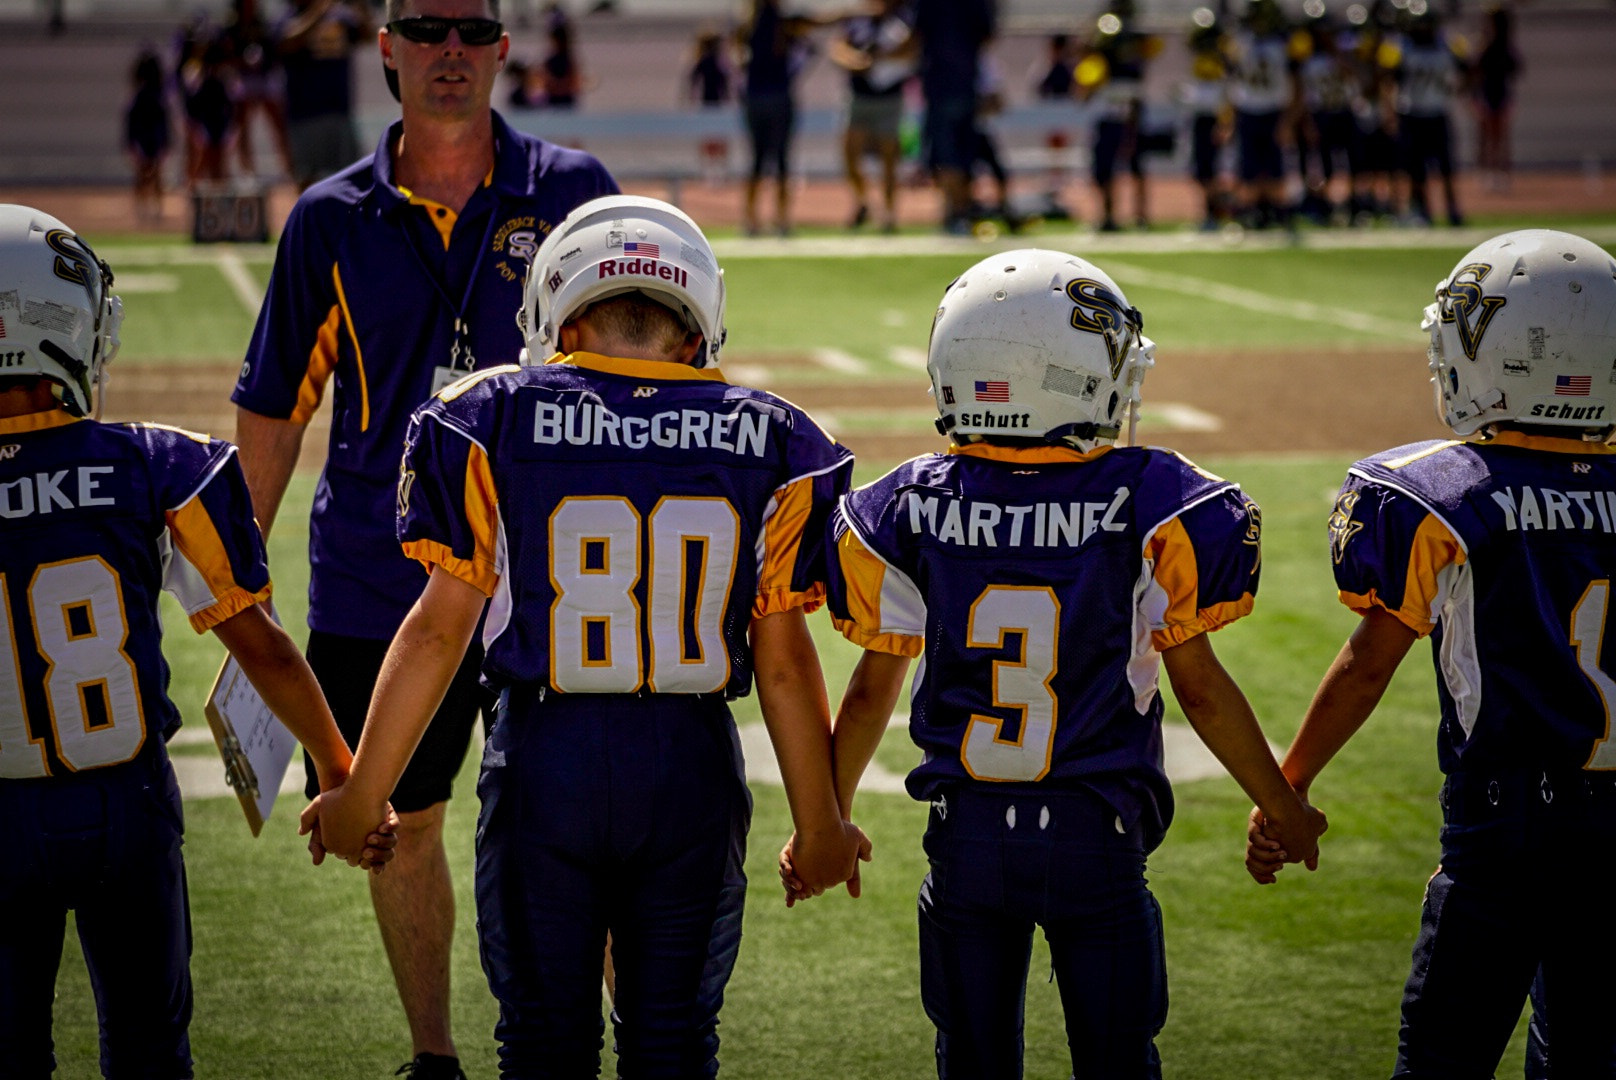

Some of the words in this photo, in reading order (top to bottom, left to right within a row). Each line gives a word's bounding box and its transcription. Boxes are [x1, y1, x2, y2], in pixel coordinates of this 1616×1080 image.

[599, 258, 687, 288] Riddell
[1440, 263, 1507, 361] SV
[534, 400, 769, 458] BURGGREN
[961, 411, 1030, 428] schutt
[1530, 402, 1605, 420] schutt
[908, 486, 1130, 548] MARTINEZ
[547, 494, 741, 694] 80
[960, 584, 1061, 783] 3
